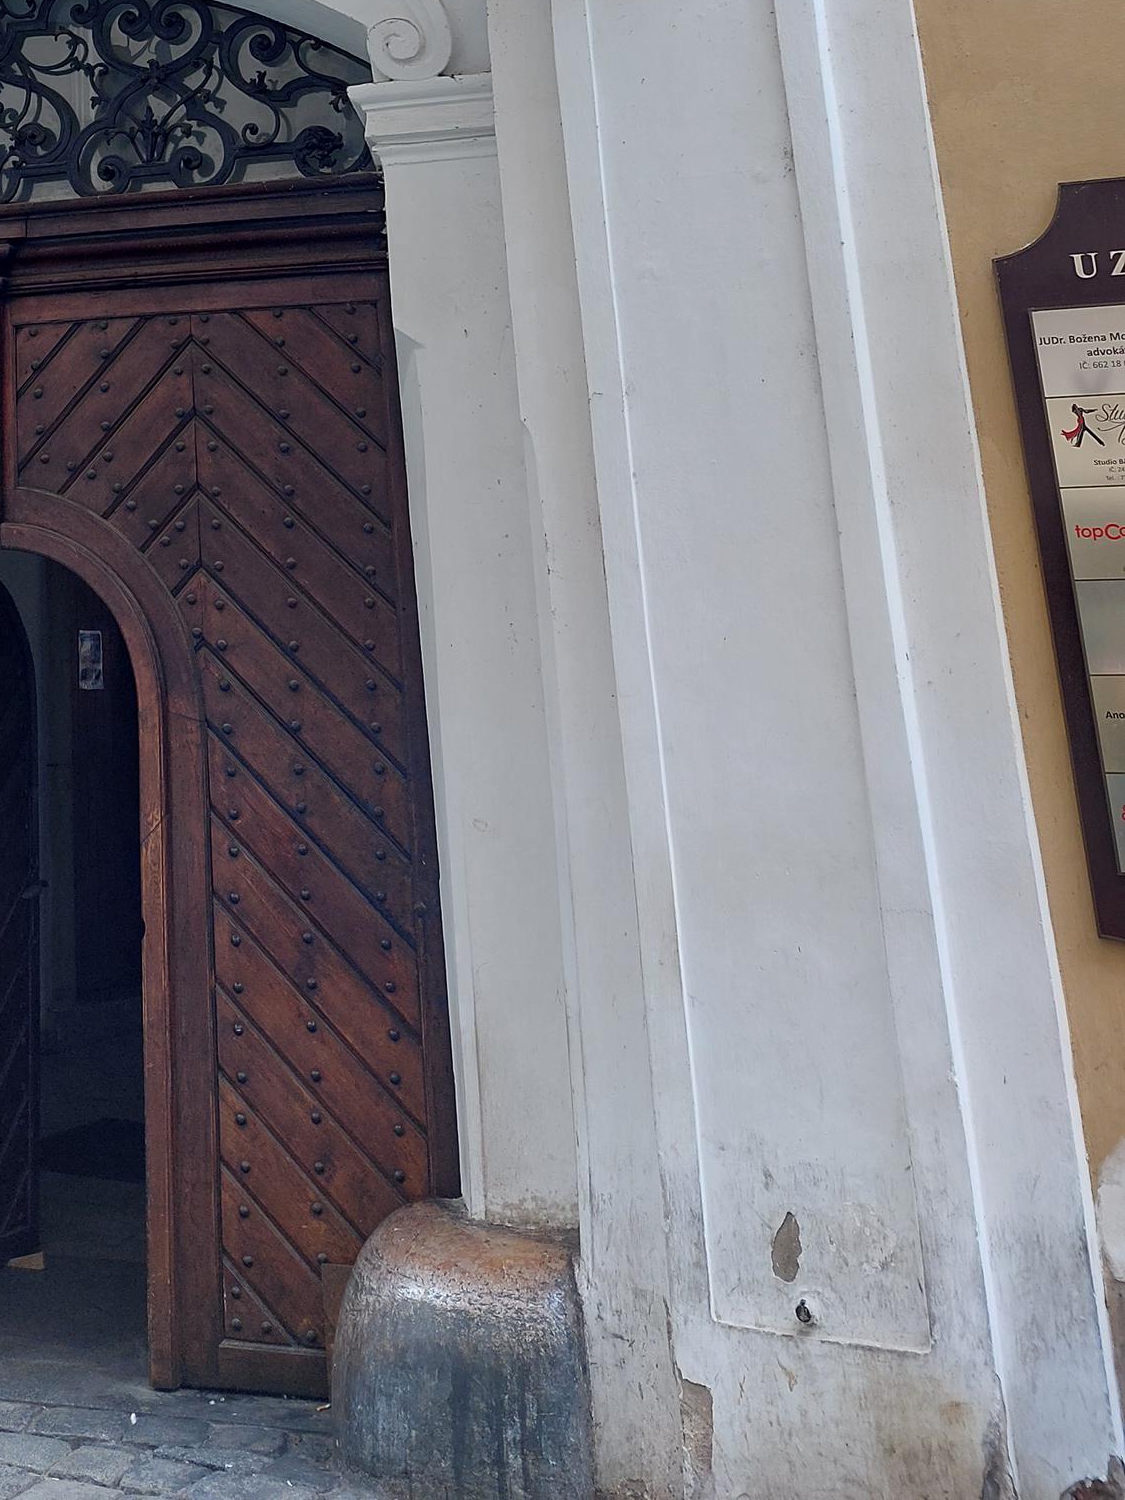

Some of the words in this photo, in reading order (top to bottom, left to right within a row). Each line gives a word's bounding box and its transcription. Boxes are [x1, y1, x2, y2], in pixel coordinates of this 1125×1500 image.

[1069, 252, 1099, 279] U
[1038, 336, 1066, 346] JUDr.
[1068, 333, 1107, 344] Božena
[1092, 360, 1109, 369] 662
[1111, 360, 1122, 368] 18
